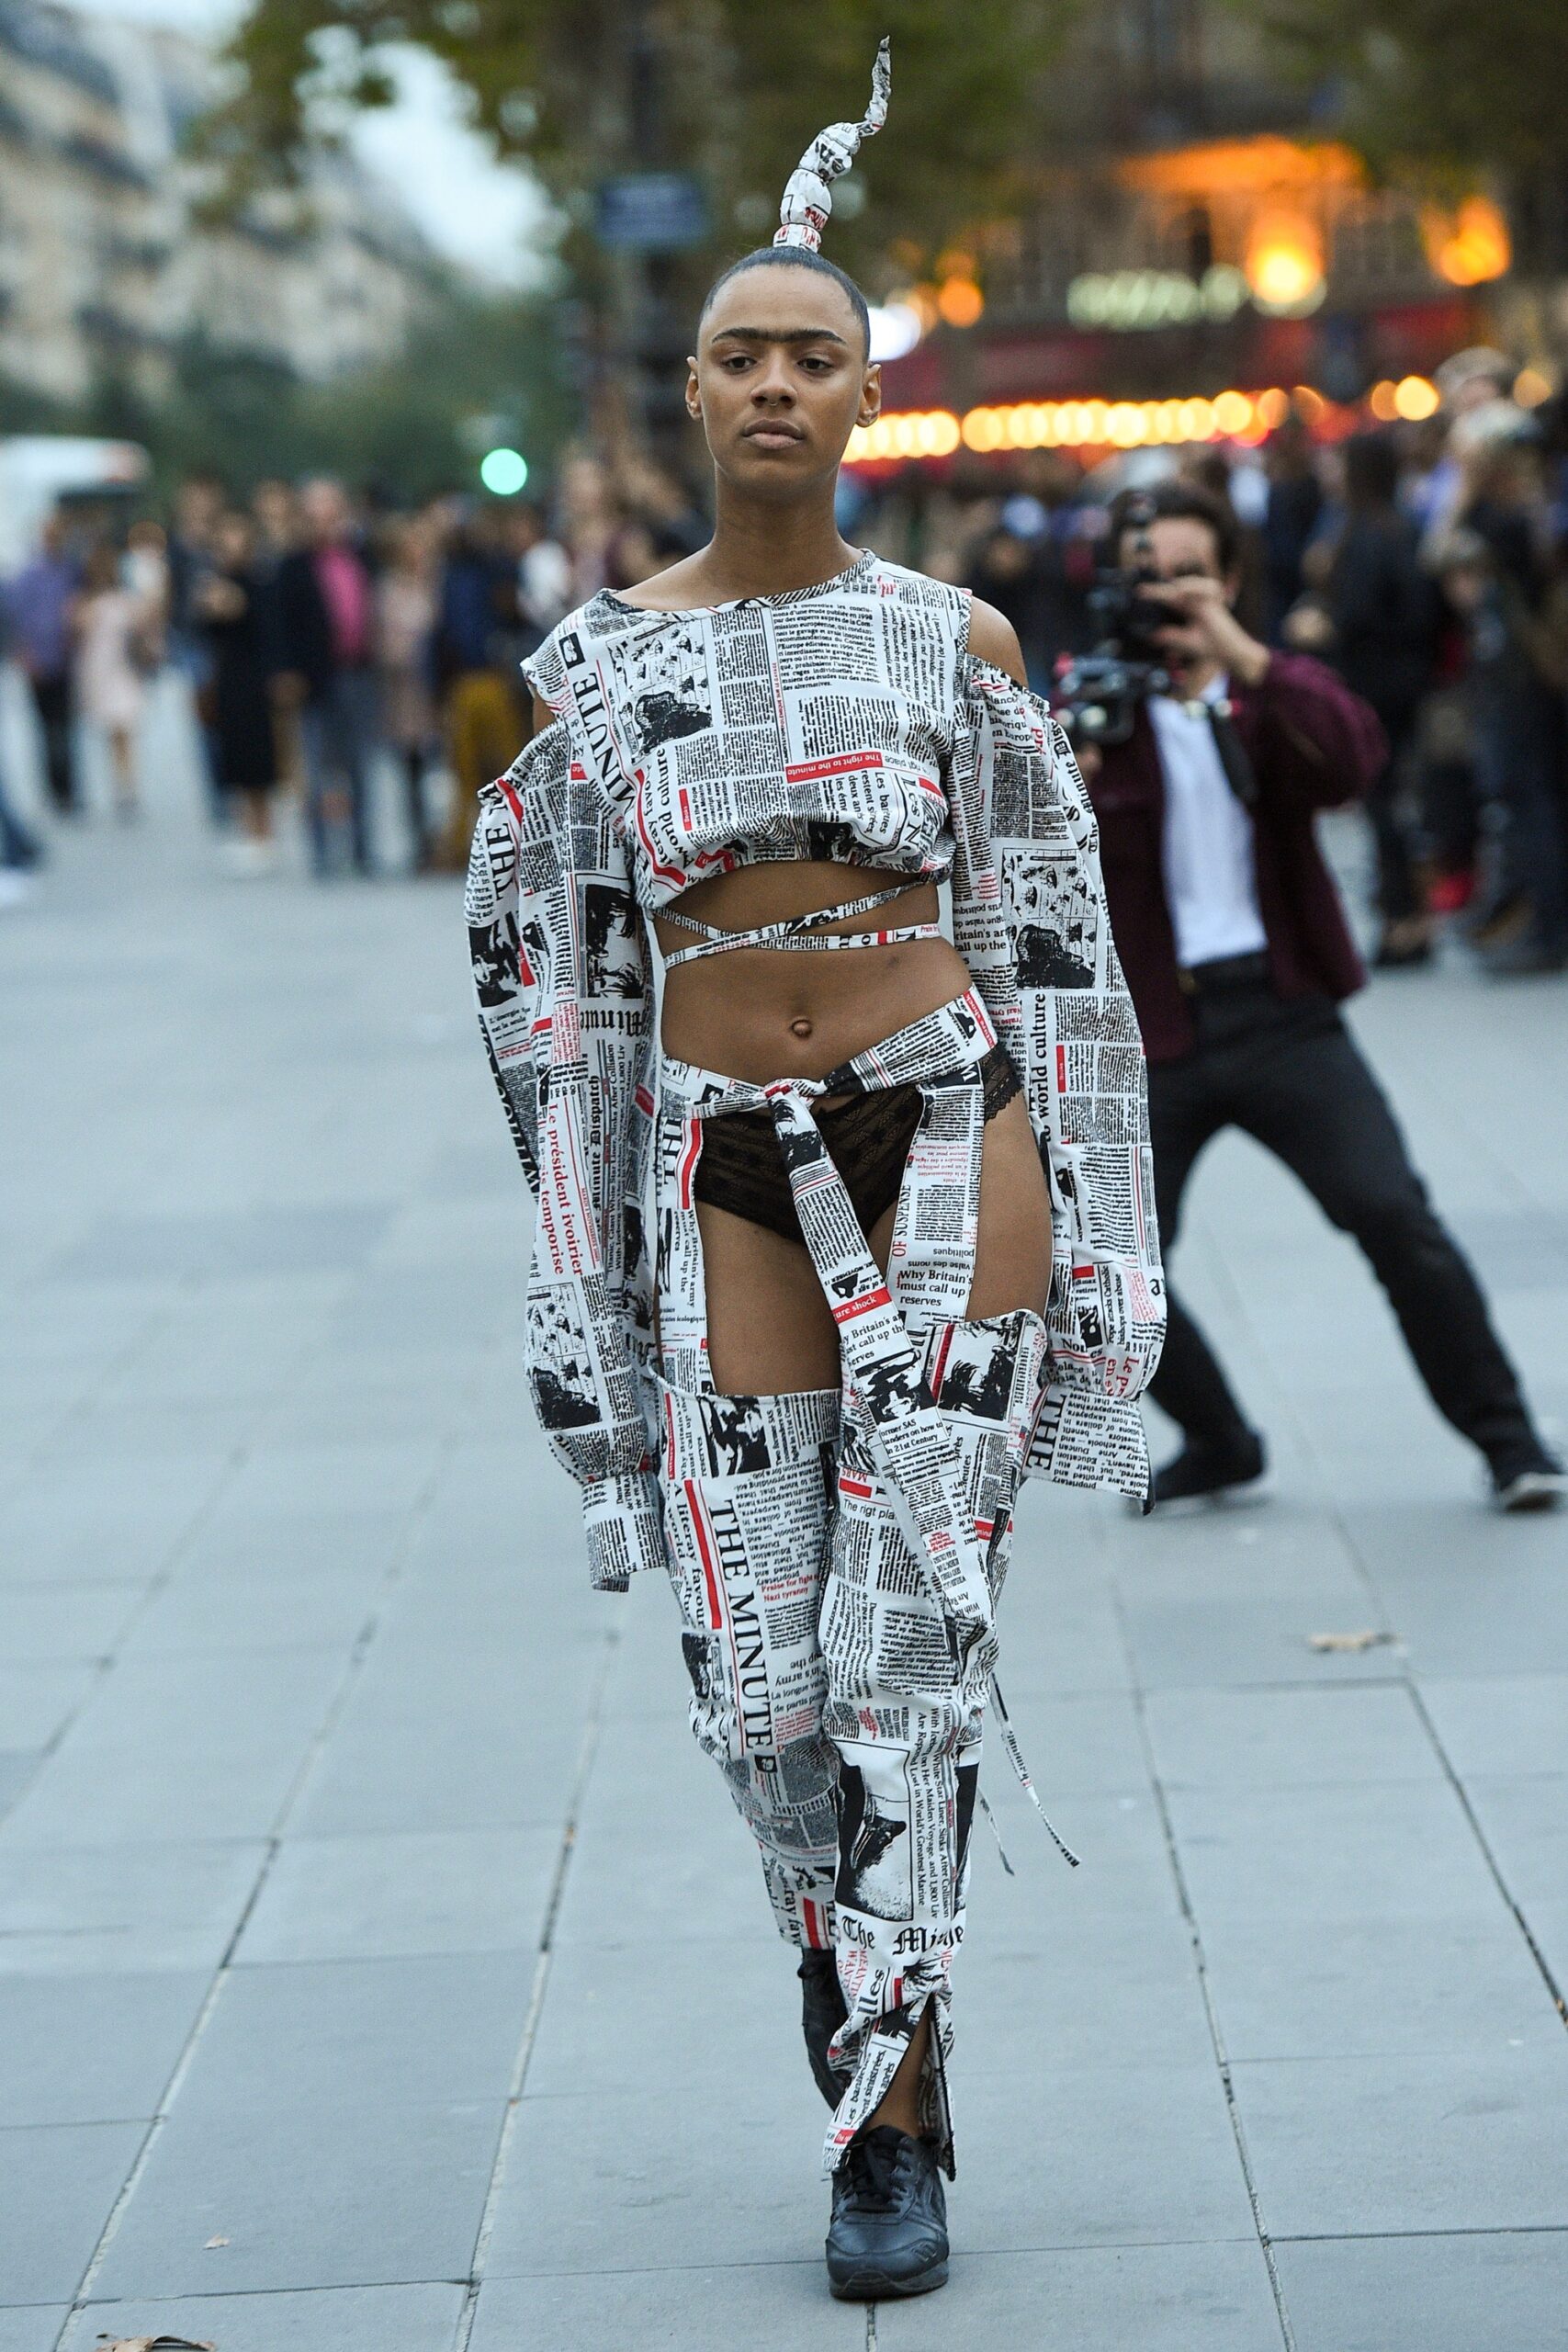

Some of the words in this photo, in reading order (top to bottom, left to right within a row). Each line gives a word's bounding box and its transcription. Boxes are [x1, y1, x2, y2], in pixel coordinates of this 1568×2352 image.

[787, 765, 817, 775] minute
[818, 762, 831, 770] the
[657, 748, 670, 806] culture
[835, 777, 844, 791] les
[848, 775, 858, 798] deux
[875, 772, 886, 789] Les
[861, 770, 874, 805] restent
[955, 928, 991, 940] ritain's
[974, 943, 987, 953] up
[989, 940, 1006, 950] the
[1030, 993, 1047, 1059] culture
[607, 1044, 617, 1084] Collision
[1032, 1065, 1051, 1119] world
[589, 1076, 603, 1147] Dispatch
[547, 1129, 571, 1209] président
[561, 1214, 583, 1276] ivoirier
[895, 1184, 911, 1237] SUSPENSE
[541, 1189, 564, 1275] temporise
[892, 1240, 908, 1258] OF
[933, 1248, 975, 1258] politiques
[949, 1262, 971, 1271] valse
[899, 1270, 925, 1281] Why
[928, 1270, 974, 1285] Britain's
[900, 1282, 927, 1292] must
[929, 1283, 948, 1294] call
[951, 1287, 965, 1298] up
[852, 1295, 877, 1311] shock
[900, 1295, 942, 1306] reserves
[851, 1317, 890, 1340] Britain's
[859, 1335, 875, 1348] call
[877, 1330, 890, 1340] up
[1123, 1356, 1140, 1374] Le
[881, 1425, 902, 1436] ormer
[902, 1419, 917, 1430] SAS
[919, 1424, 935, 1432] how
[1025, 1394, 1067, 1471] THE
[894, 1442, 910, 1453] 21st
[910, 1434, 938, 1445] Century
[1056, 1452, 1098, 1464] Education
[1052, 1476, 1097, 1489] proprietary
[843, 1498, 857, 1511] The
[860, 1501, 876, 1517] rigt
[877, 1508, 895, 1521] pla
[708, 1498, 750, 1582] THE
[678, 1503, 697, 1562] literay
[692, 1568, 705, 1629] favour
[728, 1590, 775, 1749] MINUTE
[790, 1658, 806, 1669] the
[775, 1673, 803, 1687] army
[771, 1691, 781, 1701] La
[784, 1683, 809, 1698] longue
[774, 1704, 784, 1713] de
[786, 1697, 808, 1713] partis
[932, 1750, 941, 1780] White
[909, 1768, 919, 1787] Lost
[921, 1769, 931, 1787] Her
[914, 1789, 922, 1798] in
[936, 1780, 944, 1799] Star
[925, 1788, 935, 1823] Maiden
[915, 1799, 925, 1836] World's
[939, 1828, 948, 1853] Sinks
[916, 1836, 924, 1871] Greatest
[929, 1861, 937, 1877] and
[941, 1854, 949, 1880] After
[917, 1872, 925, 1905] Marine
[930, 1878, 939, 1902] 1,800
[942, 1879, 952, 1918] Collision
[931, 1902, 940, 1918] Liv
[841, 1915, 875, 1950] The
[844, 2108, 857, 2126] Les
